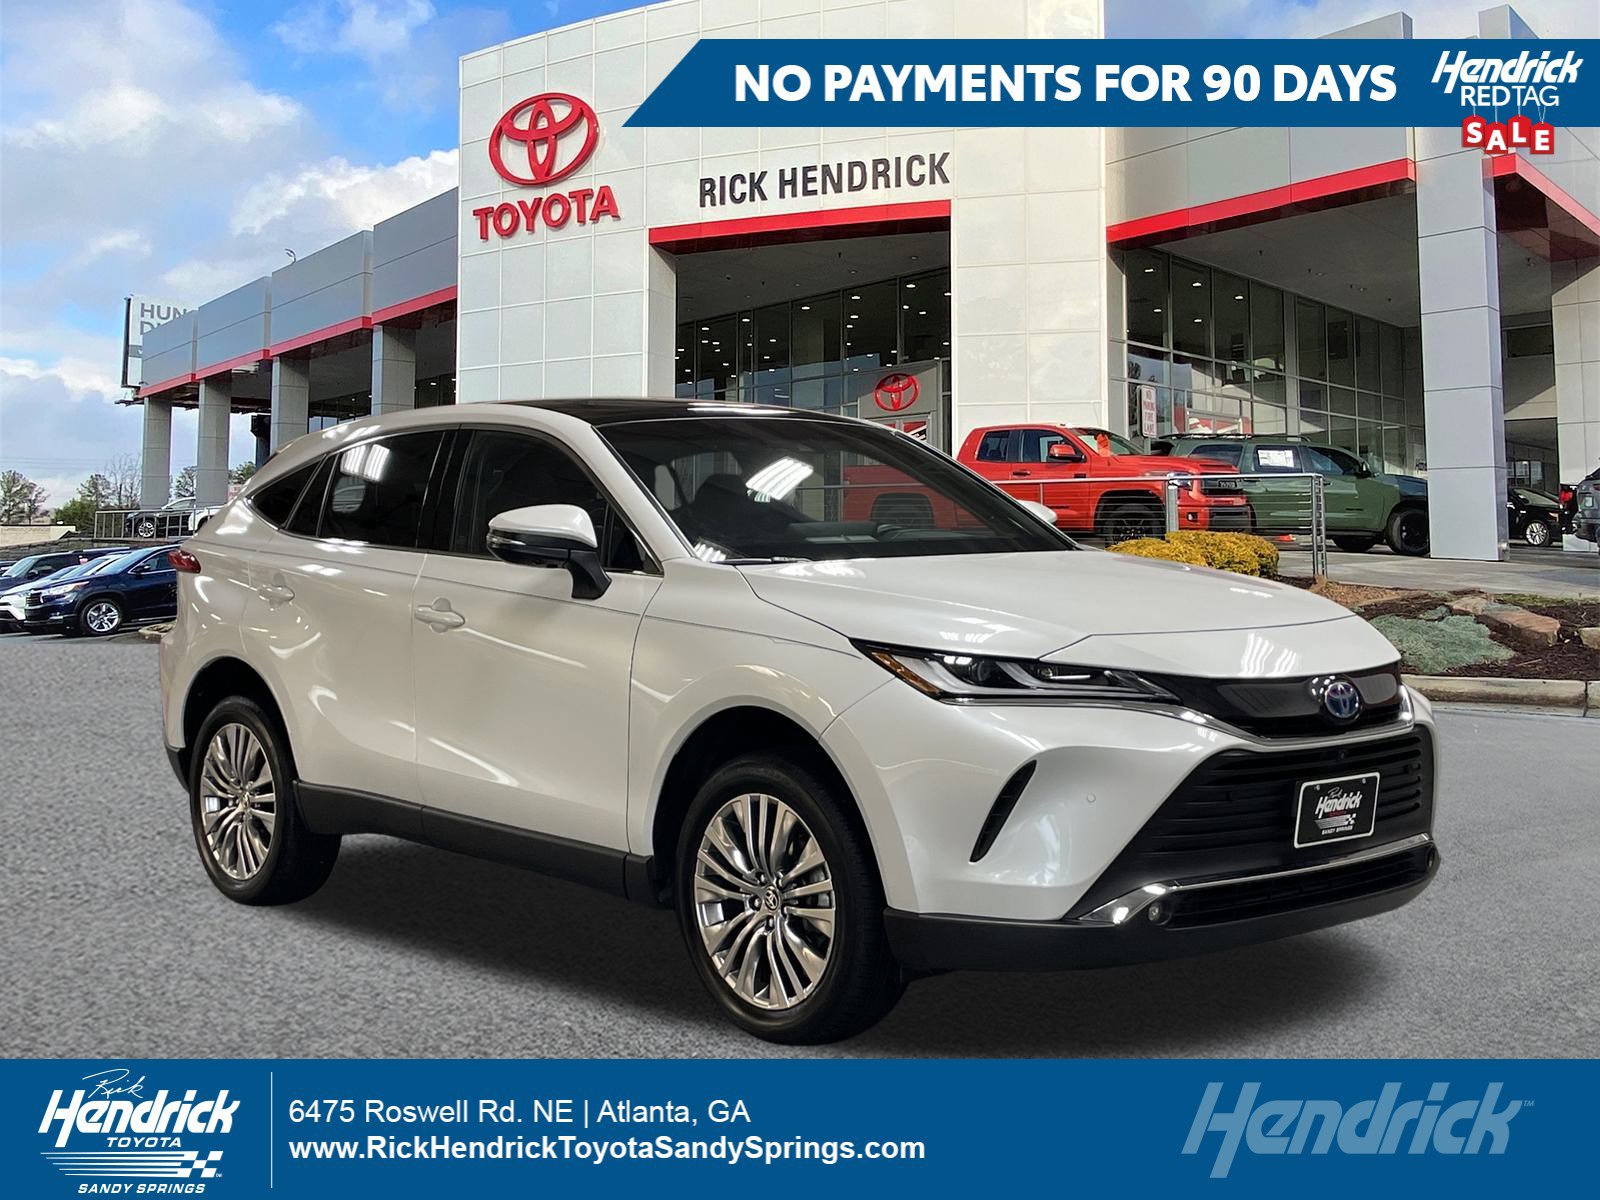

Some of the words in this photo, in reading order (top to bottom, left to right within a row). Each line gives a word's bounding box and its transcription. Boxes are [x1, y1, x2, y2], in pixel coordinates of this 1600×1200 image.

[699, 169, 768, 208] RICK
[778, 151, 950, 199] HENDRICK
[472, 185, 620, 241] TOYOTA
[1315, 791, 1363, 819] Hendrick
